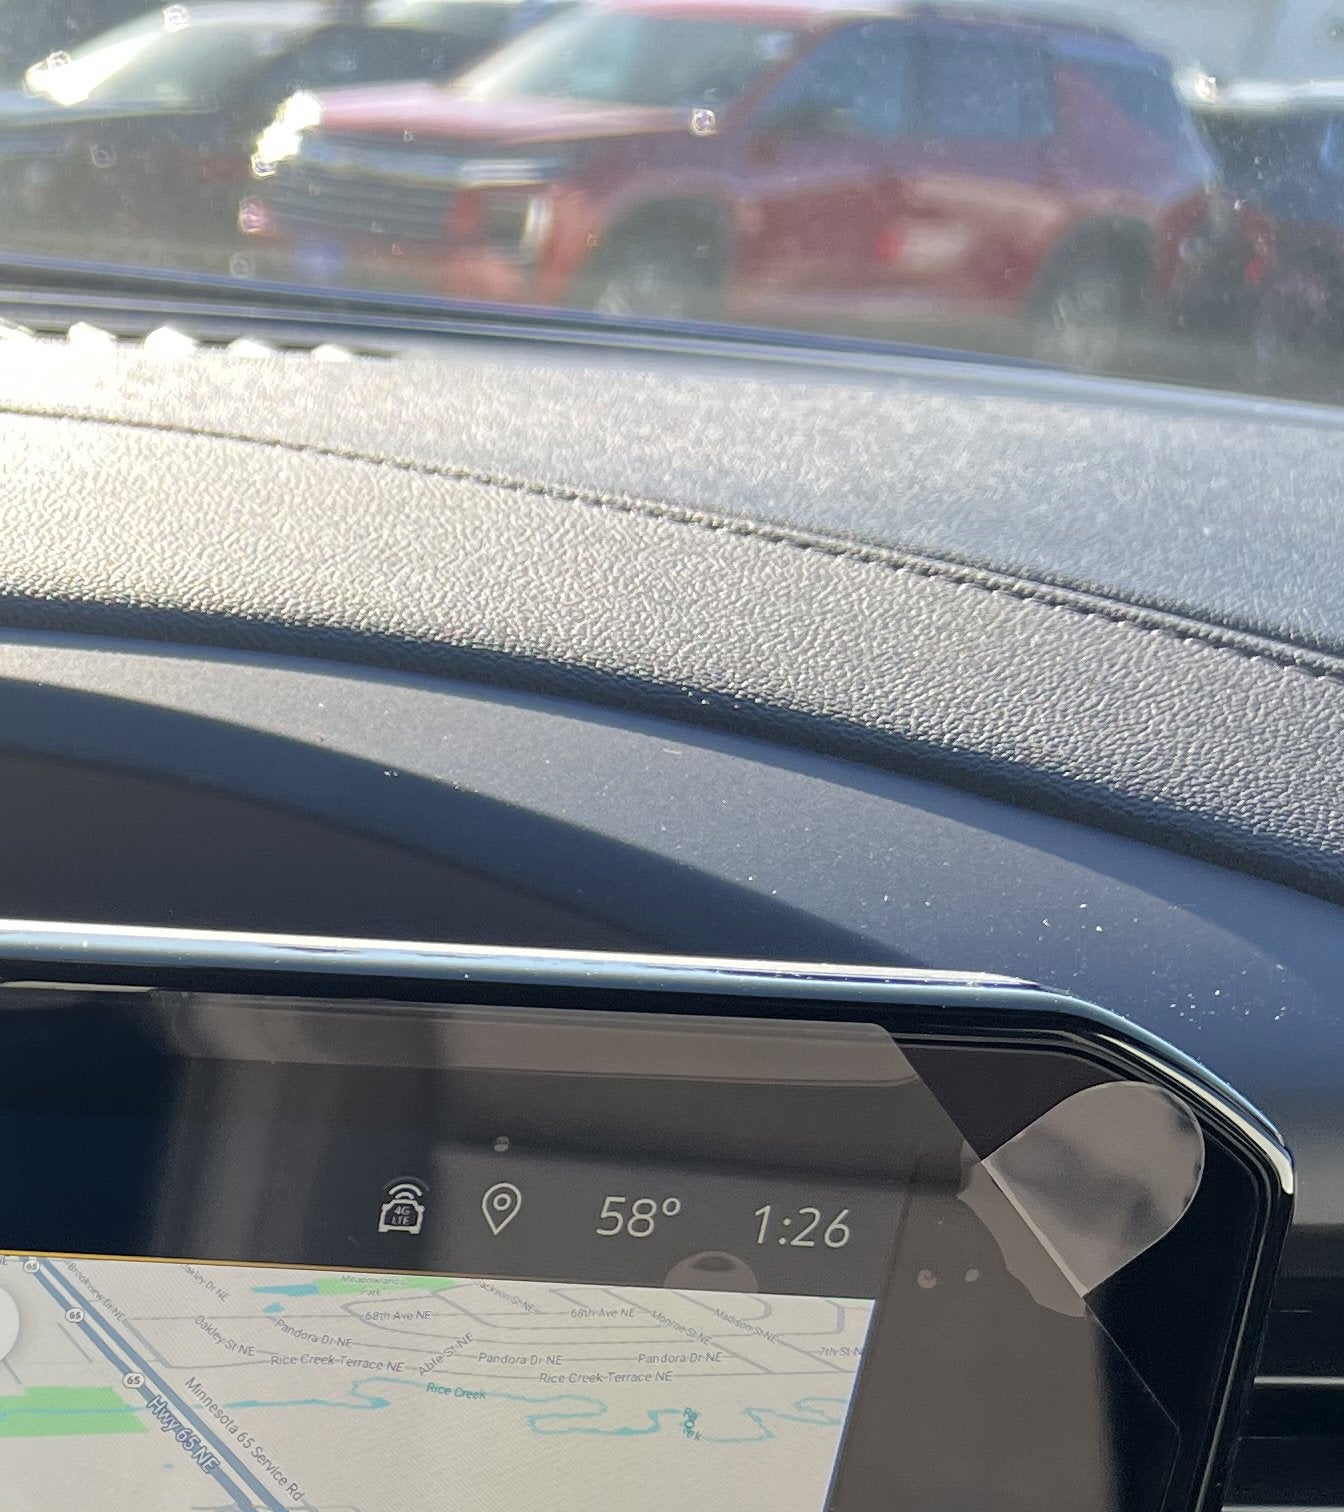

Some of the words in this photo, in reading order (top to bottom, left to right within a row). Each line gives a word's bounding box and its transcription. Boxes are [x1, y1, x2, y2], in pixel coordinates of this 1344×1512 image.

[753, 1205, 851, 1248] 1:26
[26, 1261, 37, 1270] 65
[69, 1311, 81, 1320] 65
[416, 1311, 432, 1320] NE
[621, 1309, 636, 1317] NE
[194, 1315, 224, 1344] Oakley
[238, 1345, 256, 1356] NE
[274, 1319, 319, 1343] Pandora
[336, 1337, 353, 1348] NE
[418, 1355, 444, 1376] Able
[456, 1332, 475, 1349] NE
[478, 1352, 527, 1365] Pandora
[530, 1354, 544, 1365] Dr
[546, 1355, 563, 1365] NE
[638, 1353, 687, 1363] Pandora
[689, 1353, 704, 1363] Dr
[705, 1352, 723, 1362] NE
[271, 1355, 297, 1365] Rice
[300, 1354, 335, 1365] Creek
[338, 1355, 383, 1370] Terrace
[386, 1361, 405, 1372] NE
[127, 1375, 141, 1385] 65
[539, 1373, 565, 1383] Rice
[568, 1373, 605, 1383] Creek
[607, 1371, 653, 1383] Terrace
[655, 1371, 673, 1382] NE
[426, 1382, 452, 1394] Rice
[454, 1387, 486, 1399] Creek
[146, 1395, 181, 1432] Hwy
[176, 1428, 201, 1451] 65
[192, 1445, 220, 1474] NE
[185, 1376, 239, 1435] Minnesota
[236, 1432, 255, 1449] 65
[251, 1446, 288, 1486] Service
[285, 1482, 305, 1501] Rd
